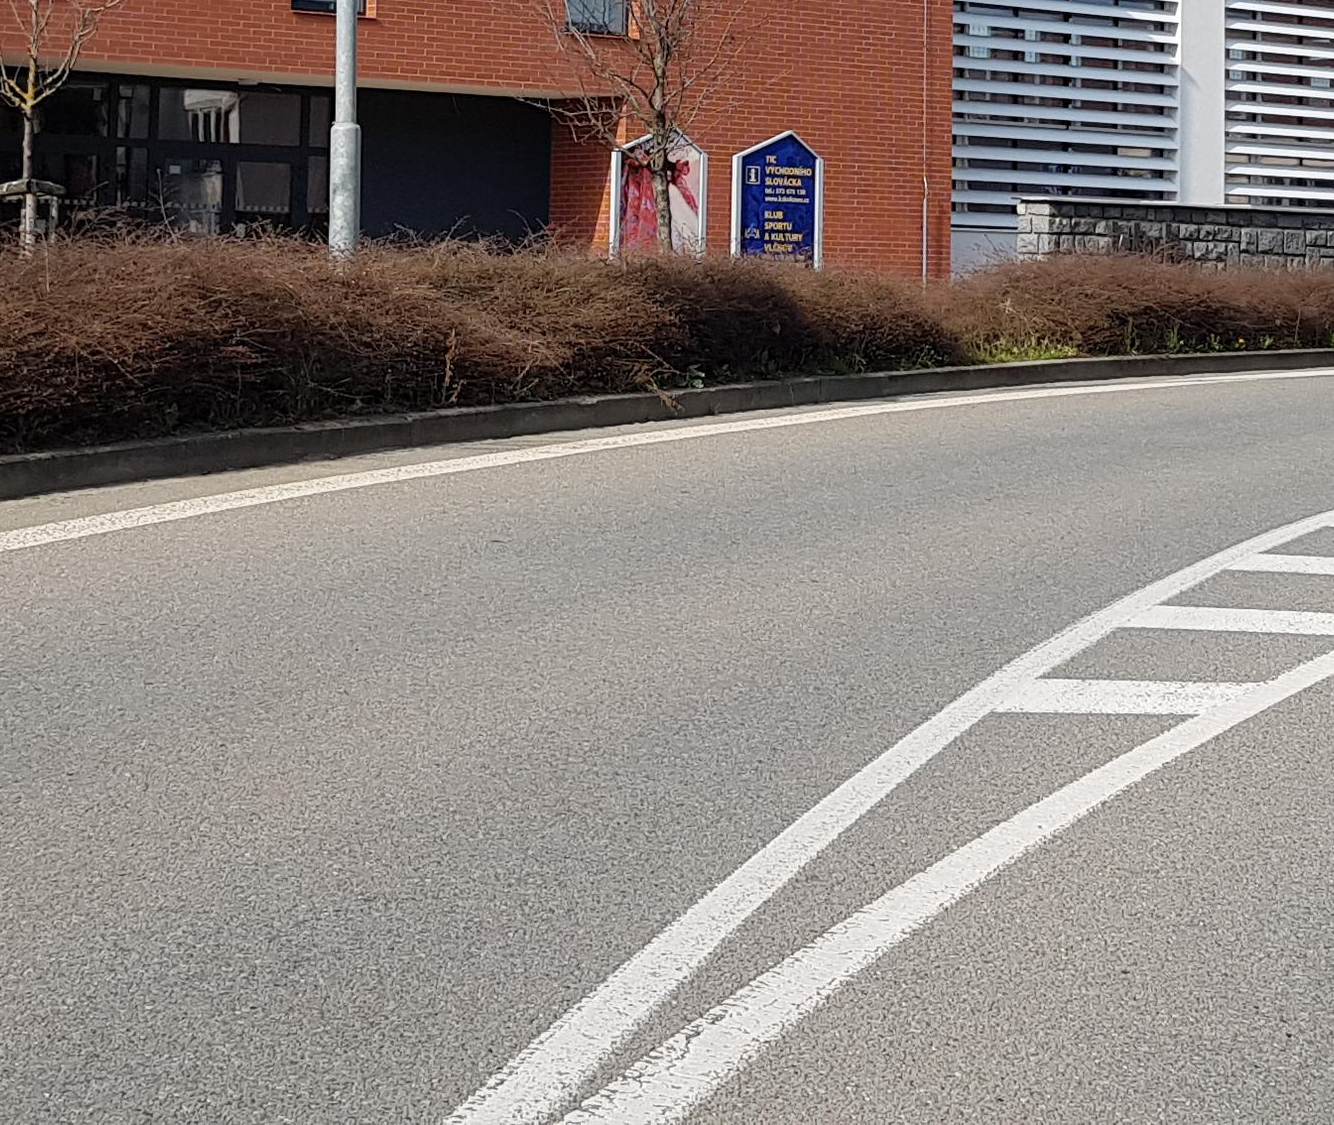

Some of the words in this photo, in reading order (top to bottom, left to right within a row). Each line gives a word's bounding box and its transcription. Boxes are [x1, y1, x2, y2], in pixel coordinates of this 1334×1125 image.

[766, 155, 777, 164] TIC
[765, 166, 812, 176] VÝCHODNÍHO
[764, 176, 802, 187] SLOVÁCKA
[764, 211, 783, 219] KLUB
[764, 222, 793, 231] SPORTU
[764, 233, 769, 241] A
[770, 233, 804, 242] KULTURY
